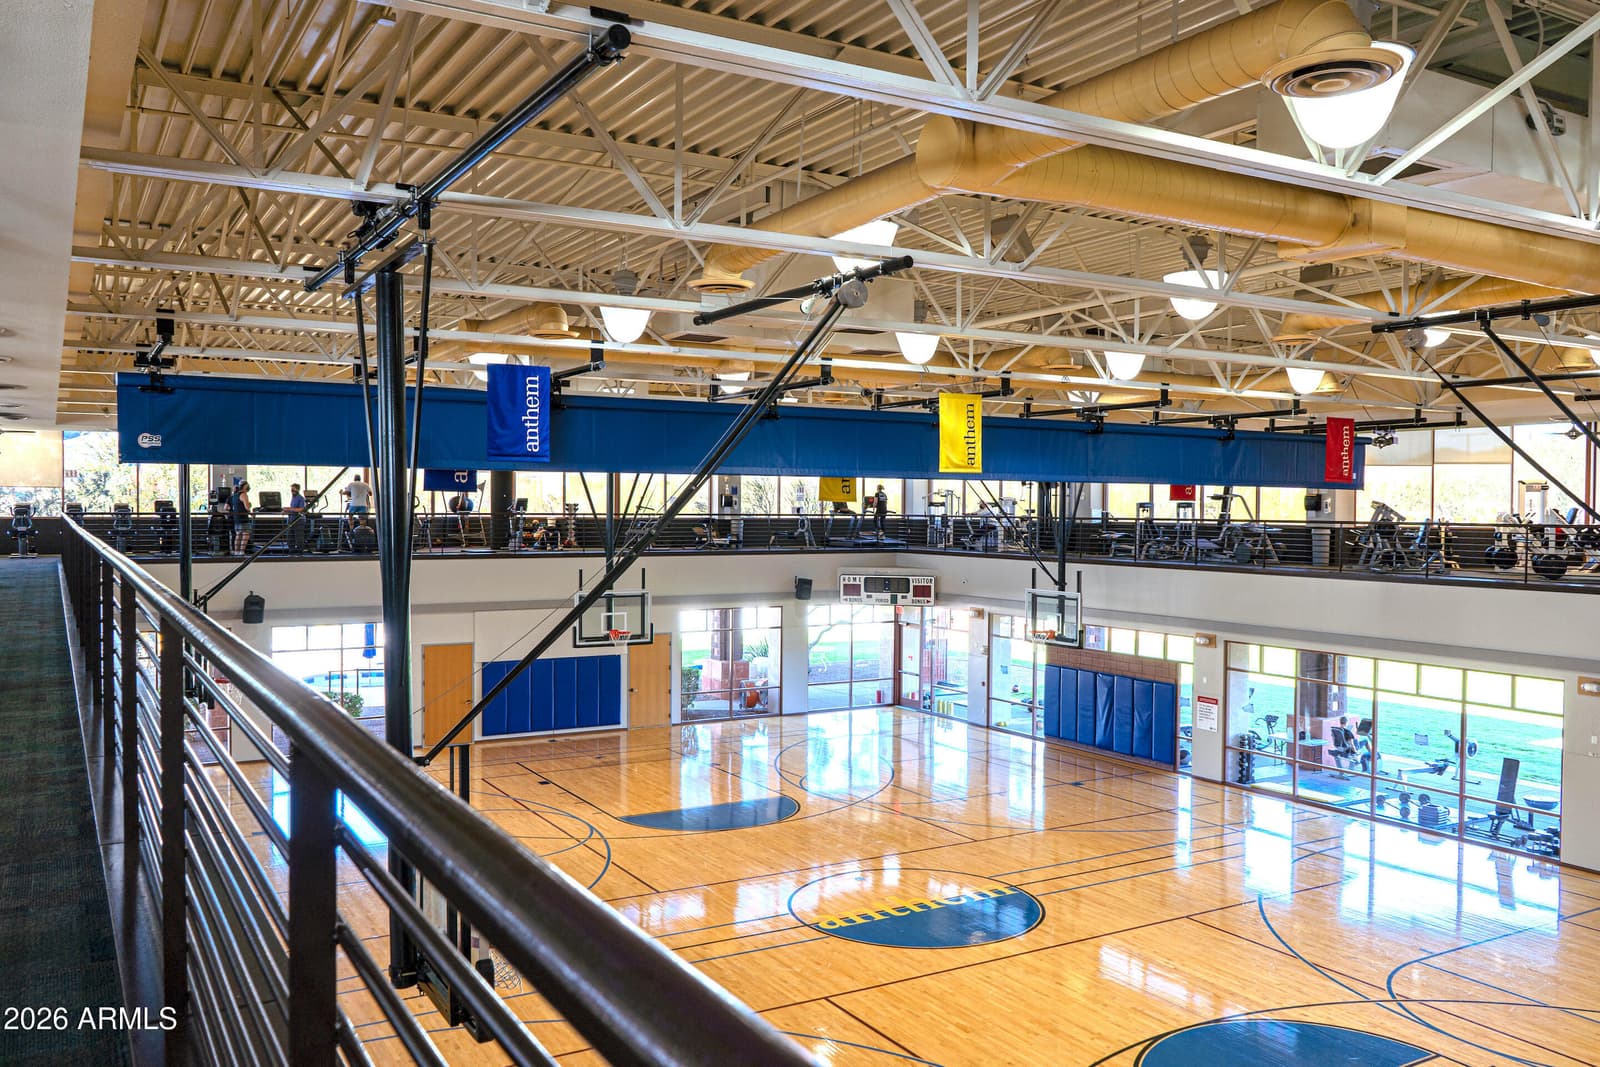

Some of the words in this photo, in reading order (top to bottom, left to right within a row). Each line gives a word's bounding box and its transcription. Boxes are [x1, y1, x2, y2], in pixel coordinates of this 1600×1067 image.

[522, 376, 540, 452] anthem
[964, 403, 976, 466] anthem
[1341, 425, 1350, 477] anthem
[911, 577, 933, 585] VISITOR
[814, 883, 1019, 930] anthem
